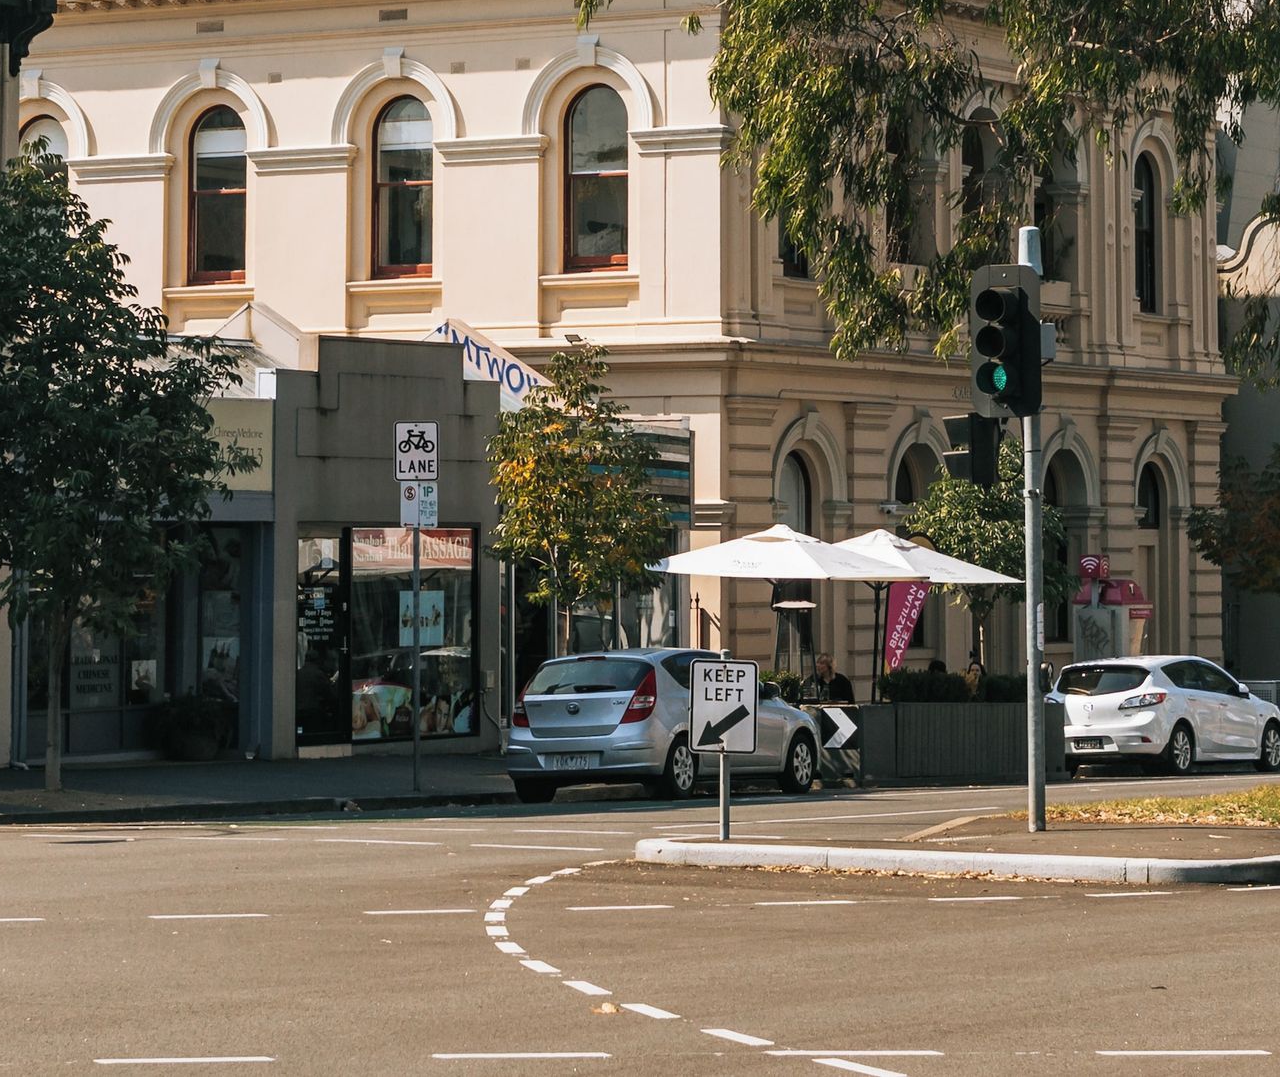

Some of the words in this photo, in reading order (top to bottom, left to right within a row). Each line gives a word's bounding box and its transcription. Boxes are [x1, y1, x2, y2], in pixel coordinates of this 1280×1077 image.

[398, 460, 435, 473] LANE
[423, 486, 434, 497] 1P
[386, 538, 412, 559] Thai
[420, 537, 469, 559] ASSAGE
[889, 585, 917, 648] BRAZILIAN
[704, 668, 746, 683] KEEP
[705, 687, 744, 702] LEFT
